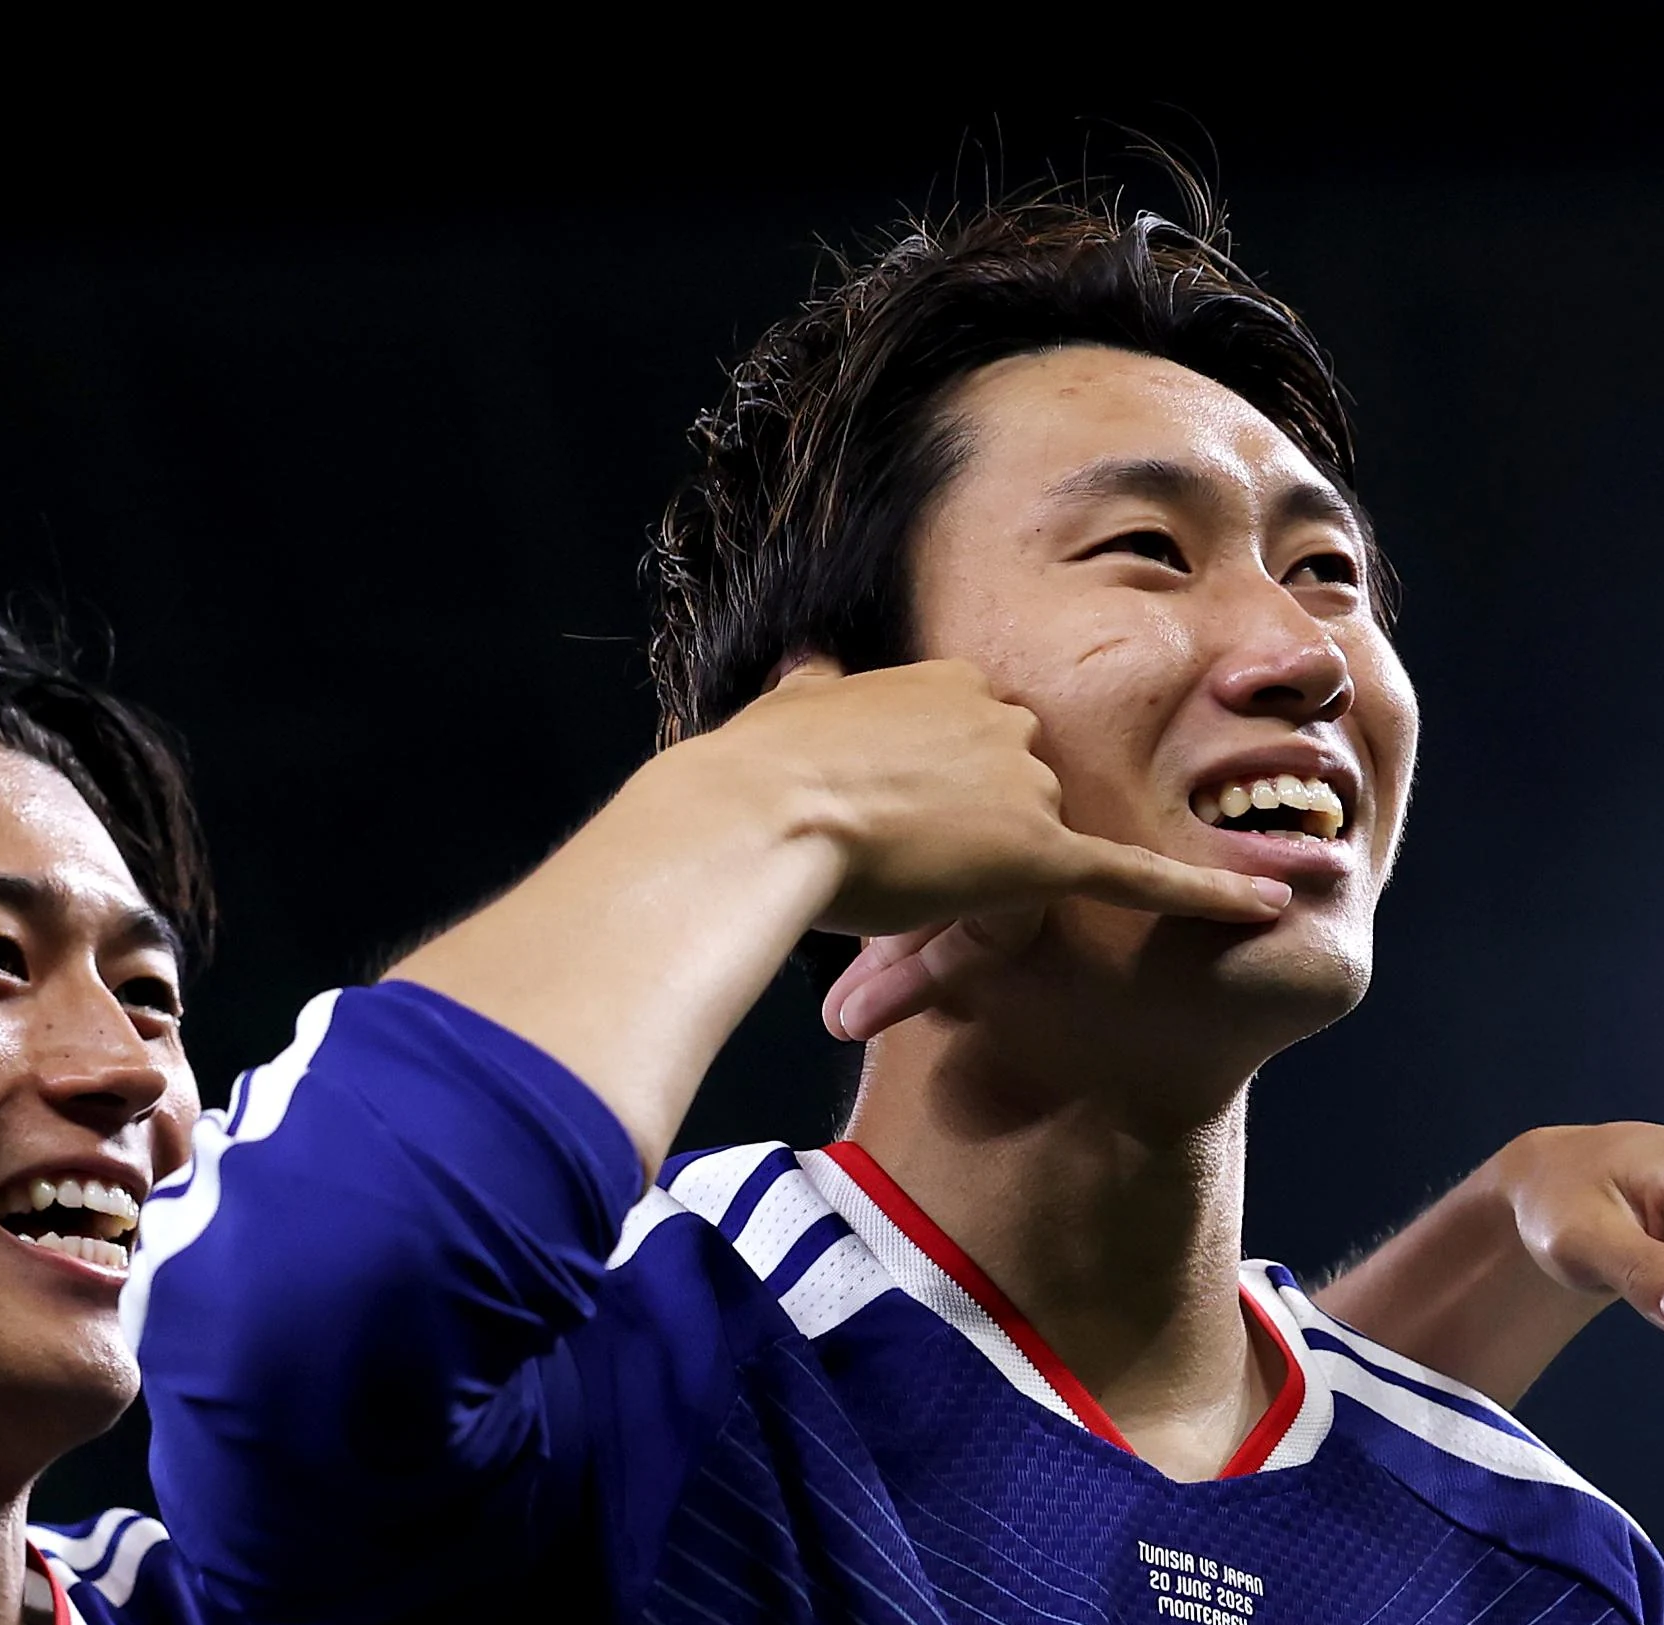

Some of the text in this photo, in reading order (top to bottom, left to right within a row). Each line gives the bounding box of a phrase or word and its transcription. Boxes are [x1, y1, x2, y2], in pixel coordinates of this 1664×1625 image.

[1137, 1540, 1195, 1574] TUNISIA
[1222, 1565, 1264, 1597] JAPAN
[1149, 1570, 1254, 1616] 20 JUNE 2026
